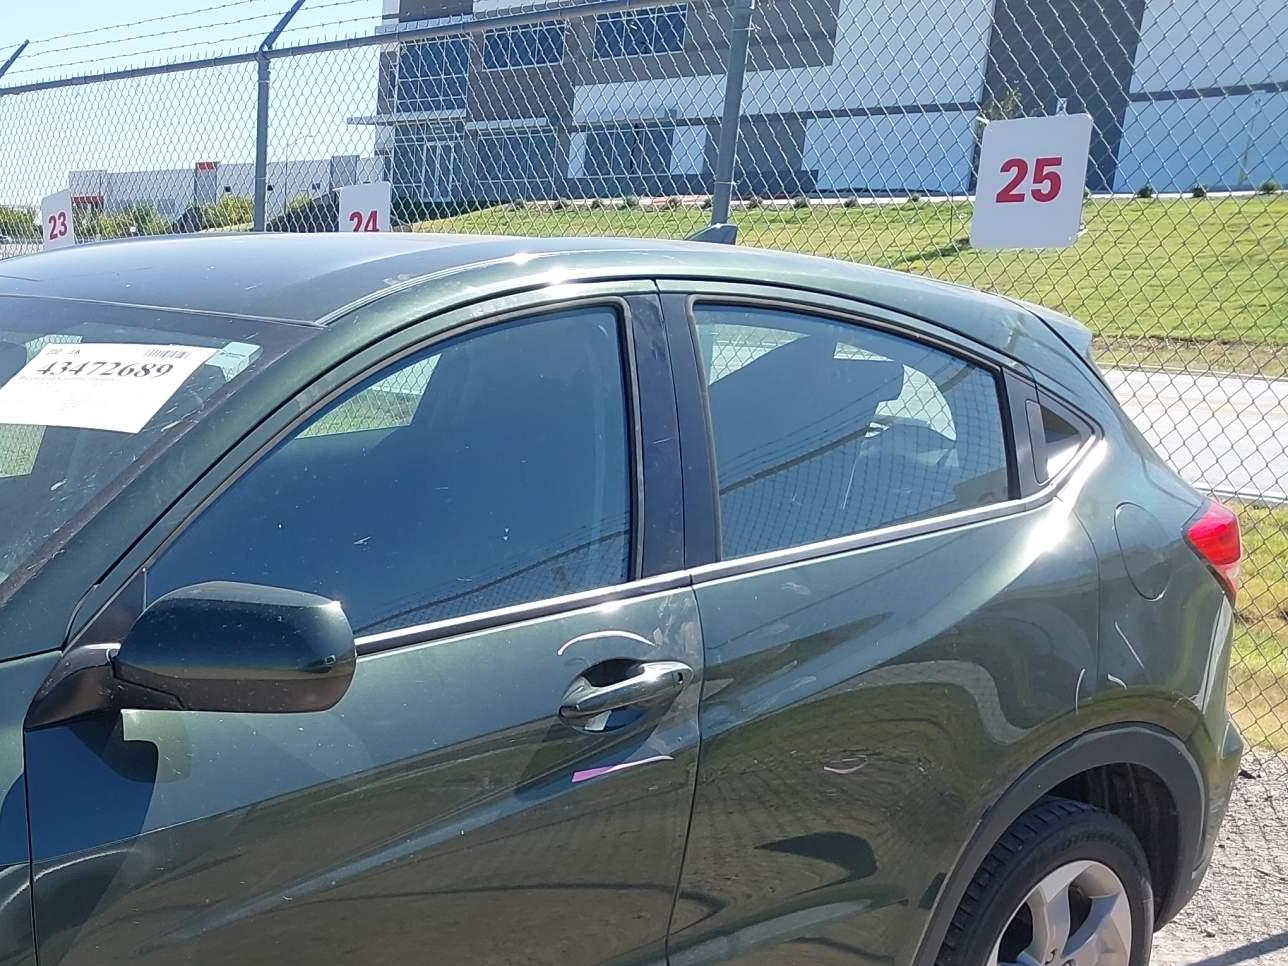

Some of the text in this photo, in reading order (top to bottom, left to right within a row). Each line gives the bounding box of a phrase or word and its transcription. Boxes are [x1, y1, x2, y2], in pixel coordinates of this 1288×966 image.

[995, 156, 1063, 204] 25
[48, 211, 68, 241] 23
[349, 209, 380, 233] 24
[37, 360, 174, 379] 43472689
